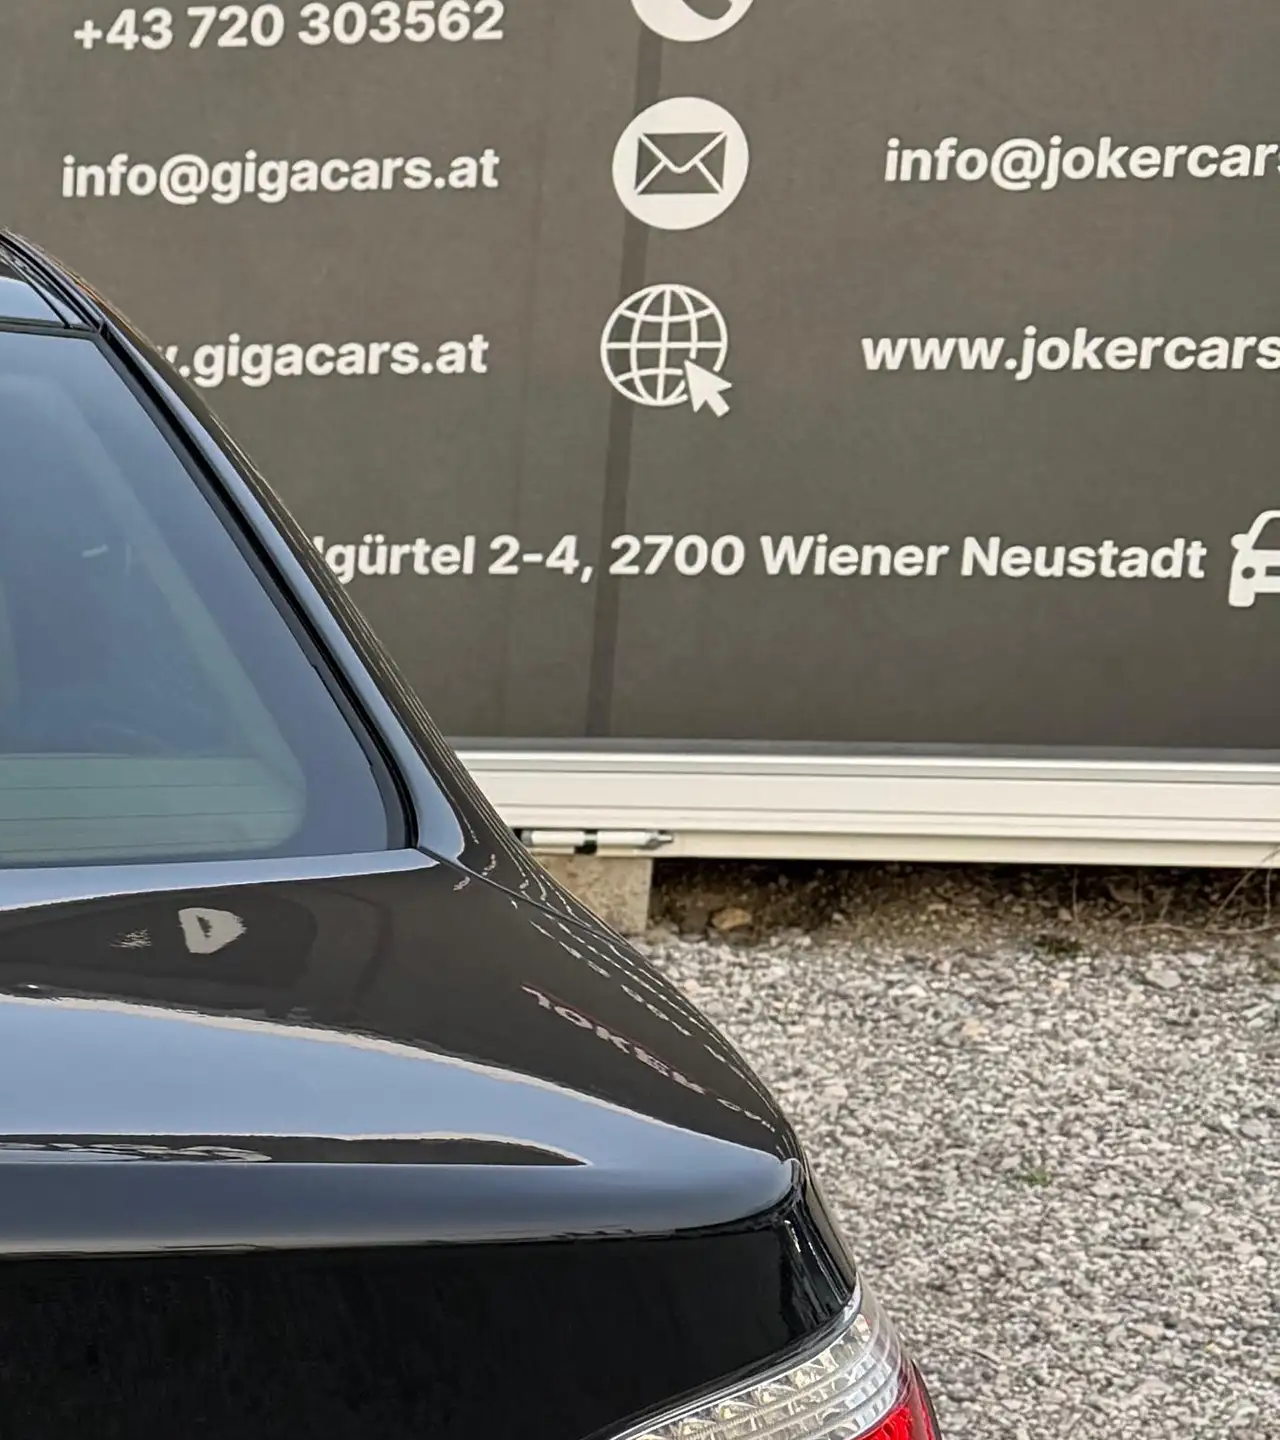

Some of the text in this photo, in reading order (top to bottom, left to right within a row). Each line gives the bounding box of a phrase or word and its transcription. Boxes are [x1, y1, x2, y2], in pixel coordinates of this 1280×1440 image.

[73, 0, 505, 51] +43 720 303562
[62, 148, 501, 205] info@gigacars.at
[884, 135, 1280, 190] info@jokercar
[488, 534, 593, 584] 2-4,
[609, 534, 745, 576] 2700
[759, 533, 950, 577] Wiener
[960, 536, 1208, 579] Neustadt
